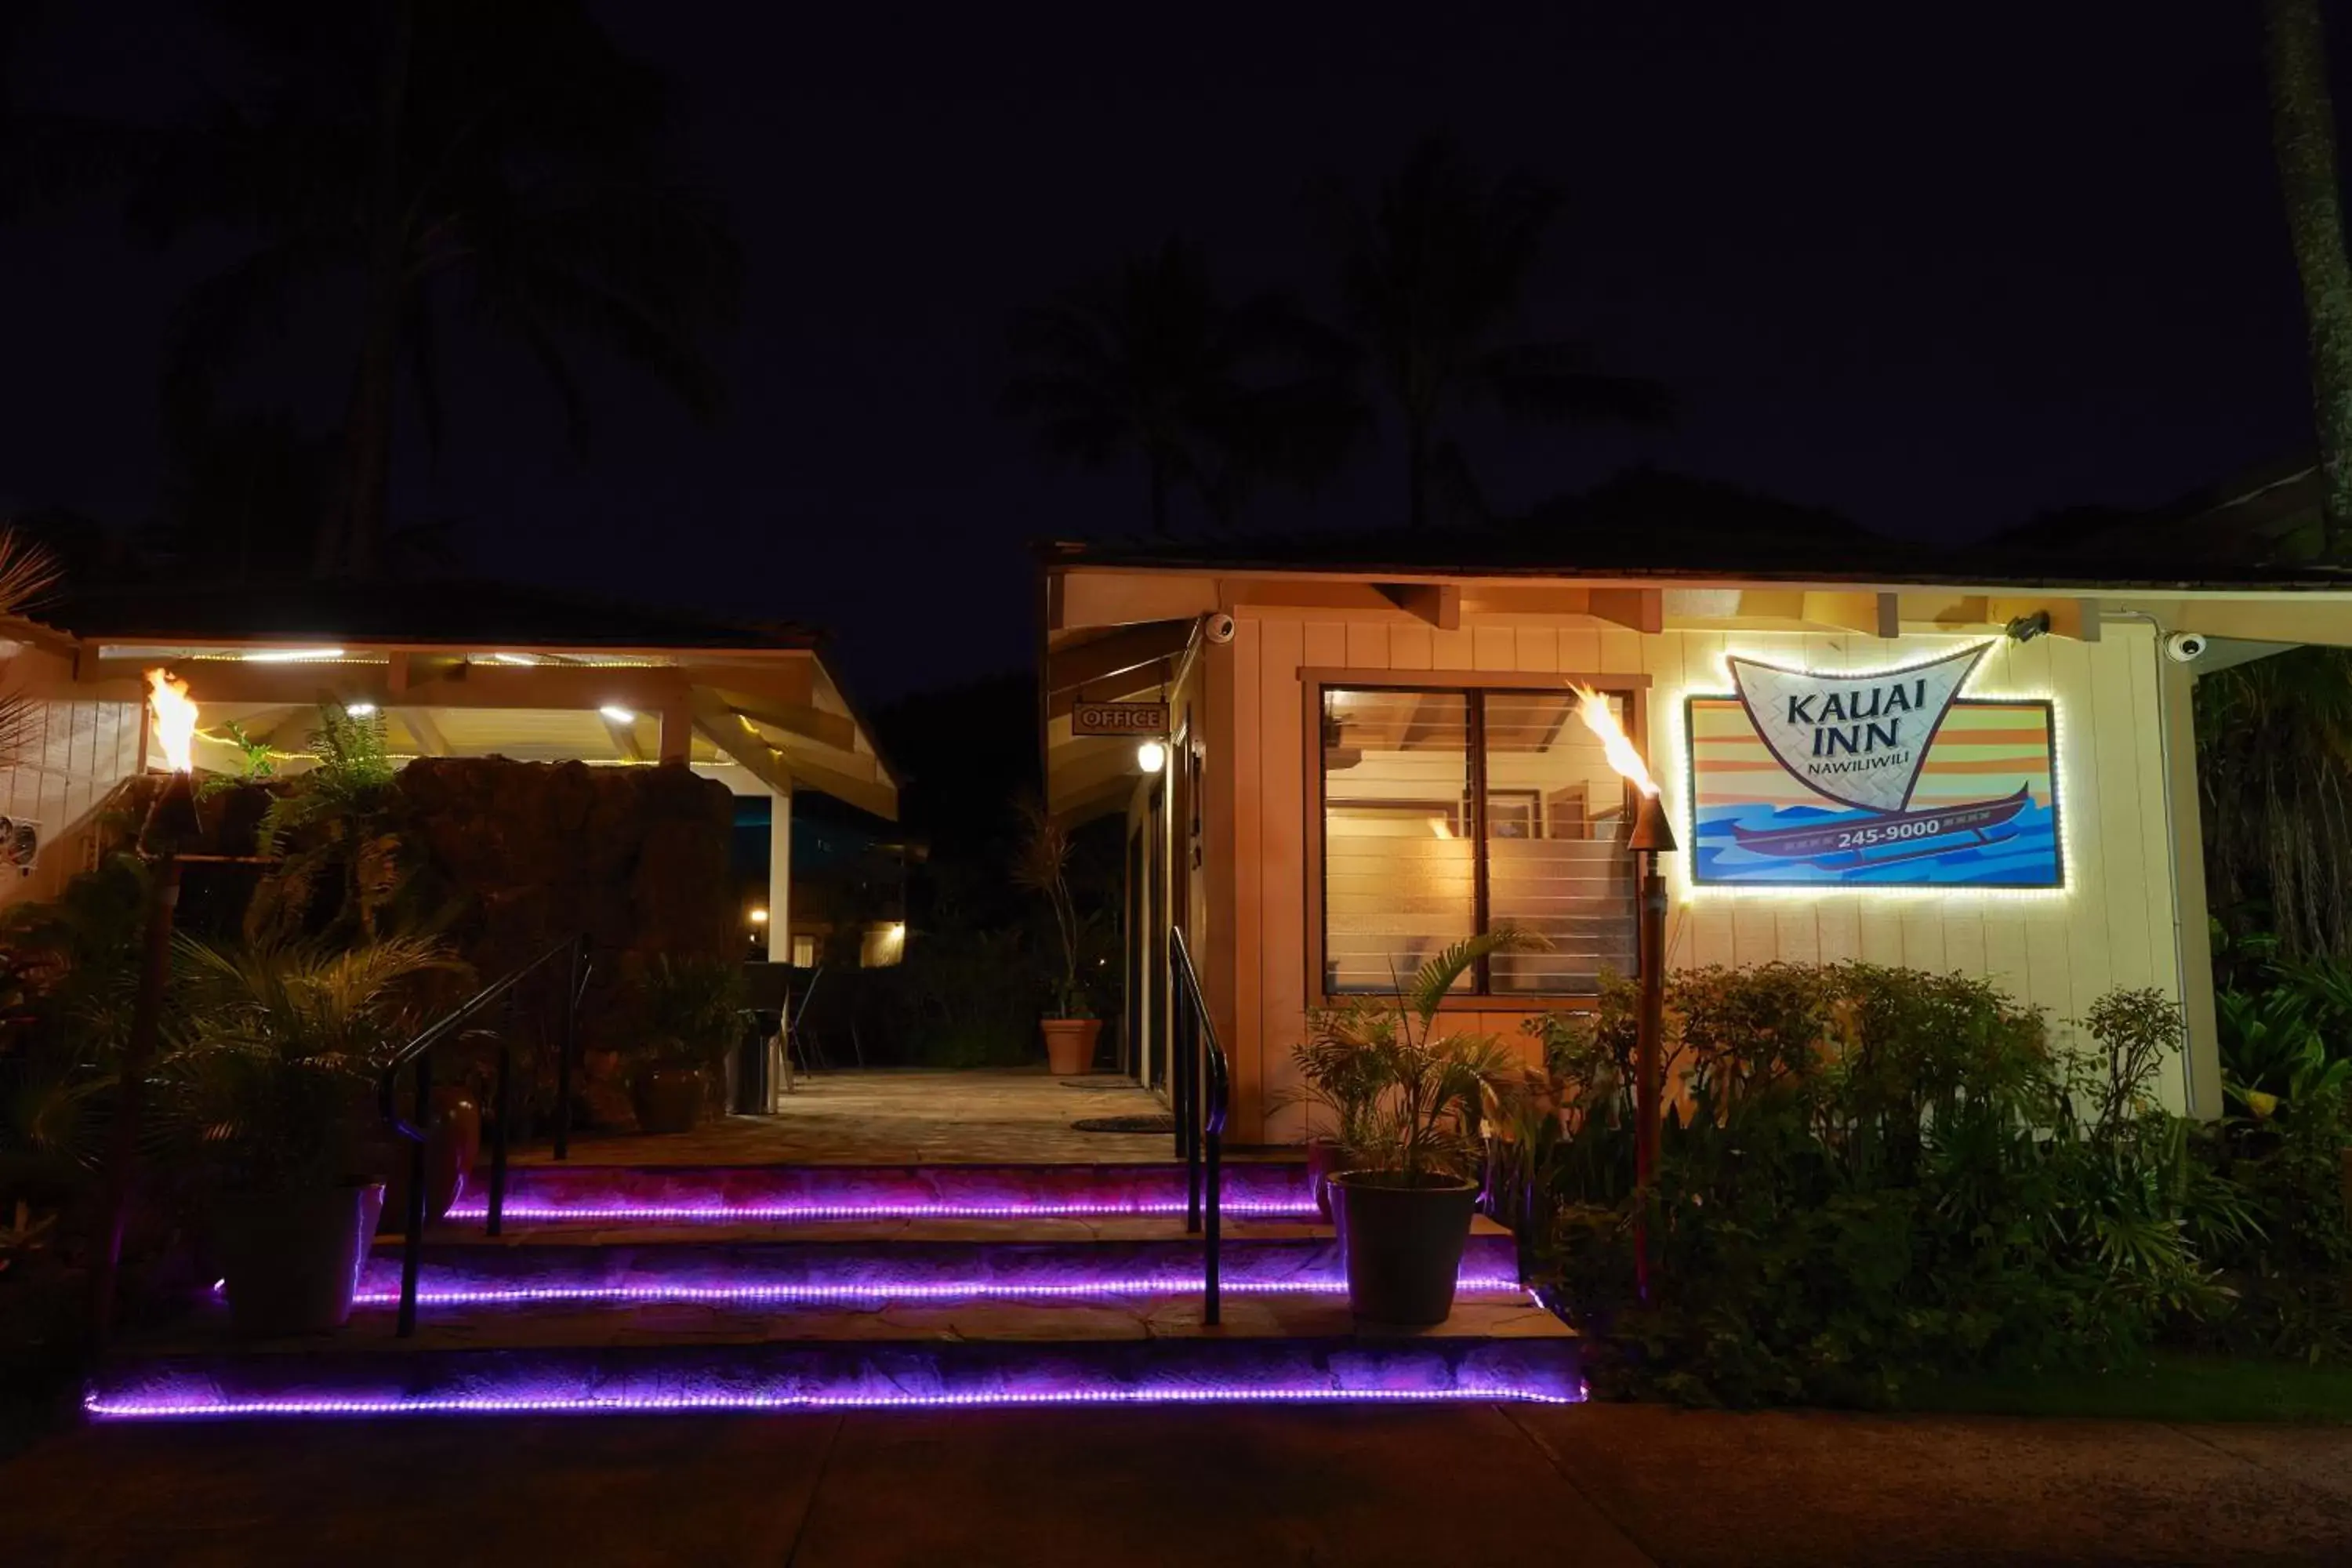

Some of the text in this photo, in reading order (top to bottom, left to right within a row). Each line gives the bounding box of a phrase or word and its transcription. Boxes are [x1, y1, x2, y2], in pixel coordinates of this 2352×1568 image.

[1788, 679, 1926, 724] KAUAI
[1083, 710, 1160, 728] OFFICE
[1813, 717, 1900, 757] INN
[1809, 752, 1909, 775] NAWILIWILI
[1839, 819, 1940, 848] 245-9000
